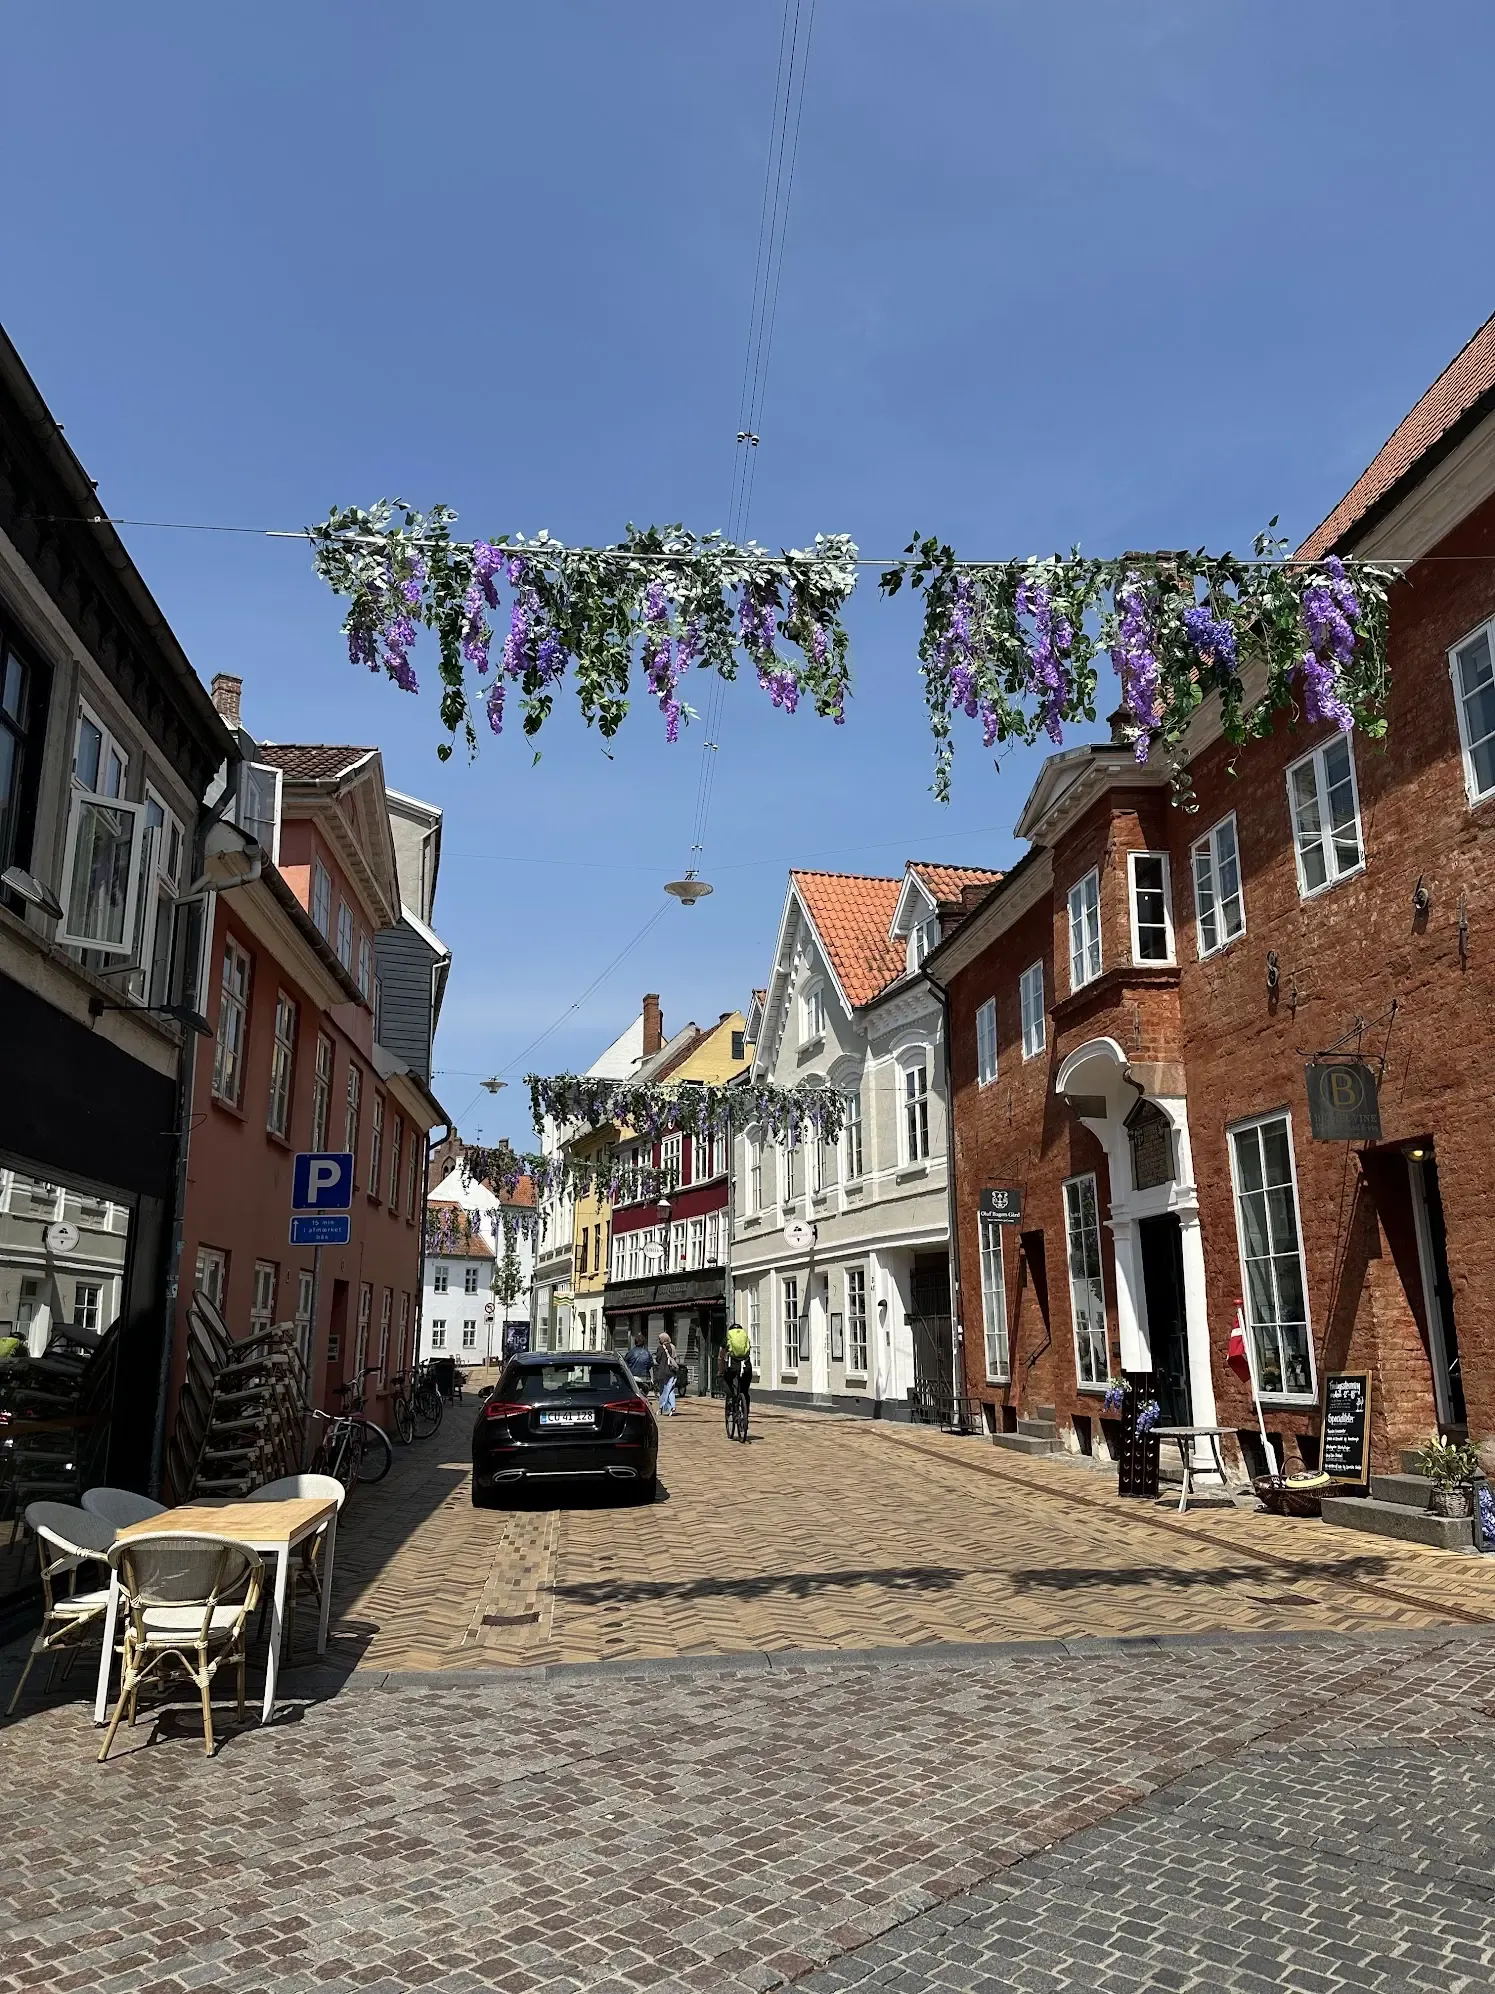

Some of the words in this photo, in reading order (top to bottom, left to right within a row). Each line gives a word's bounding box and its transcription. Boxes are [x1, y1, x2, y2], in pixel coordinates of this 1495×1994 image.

[1331, 1073, 1355, 1105] B
[307, 1160, 341, 1203] P
[548, 1411, 560, 1422] CU
[562, 1411, 573, 1421] 41
[576, 1410, 593, 1421] 128
